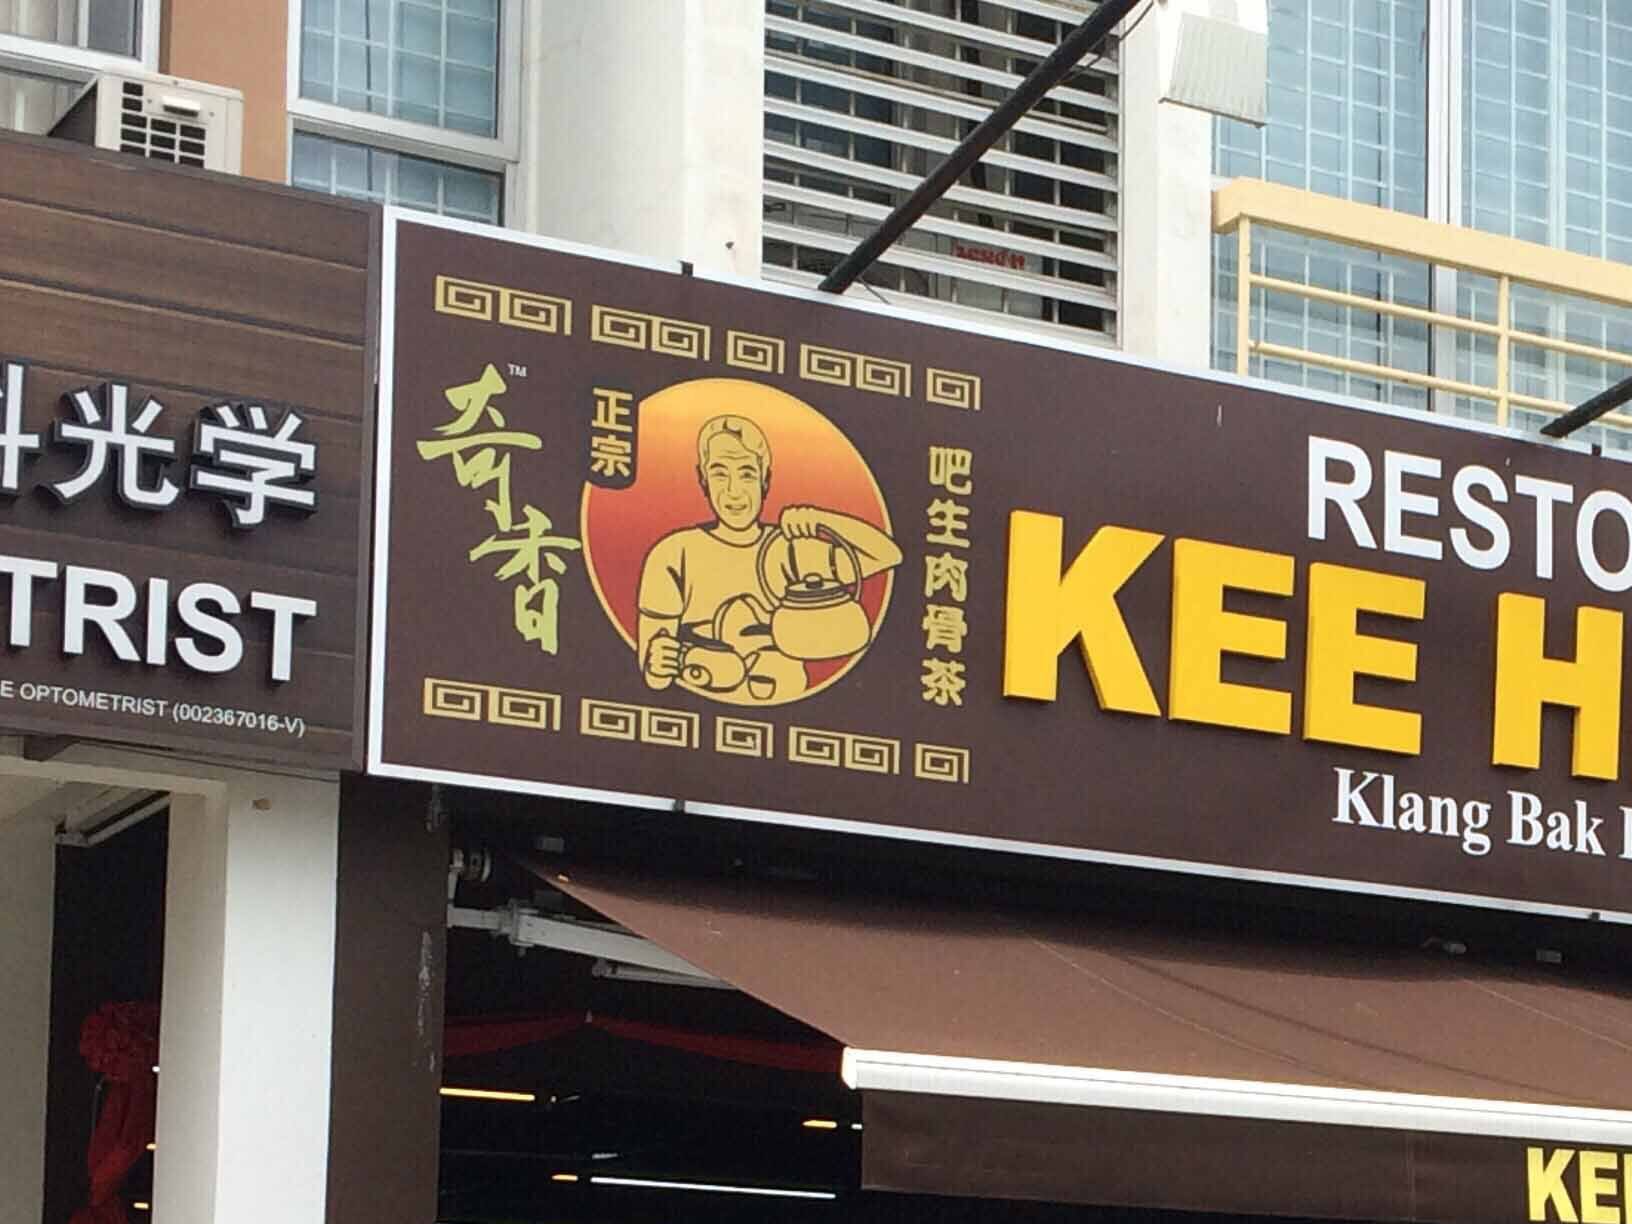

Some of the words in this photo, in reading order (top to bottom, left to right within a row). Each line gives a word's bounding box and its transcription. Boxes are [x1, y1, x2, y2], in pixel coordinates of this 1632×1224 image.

[417, 363, 581, 655] 奇香
[590, 388, 634, 478] 正宗
[921, 446, 974, 707] 吧生肉骨茶
[1003, 510, 1427, 756] KEE
[19, 682, 168, 717] OPTOMETRIST
[172, 702, 305, 738] (002367016-V)
[1332, 767, 1491, 856] Klang
[1506, 790, 1606, 857] Bak
